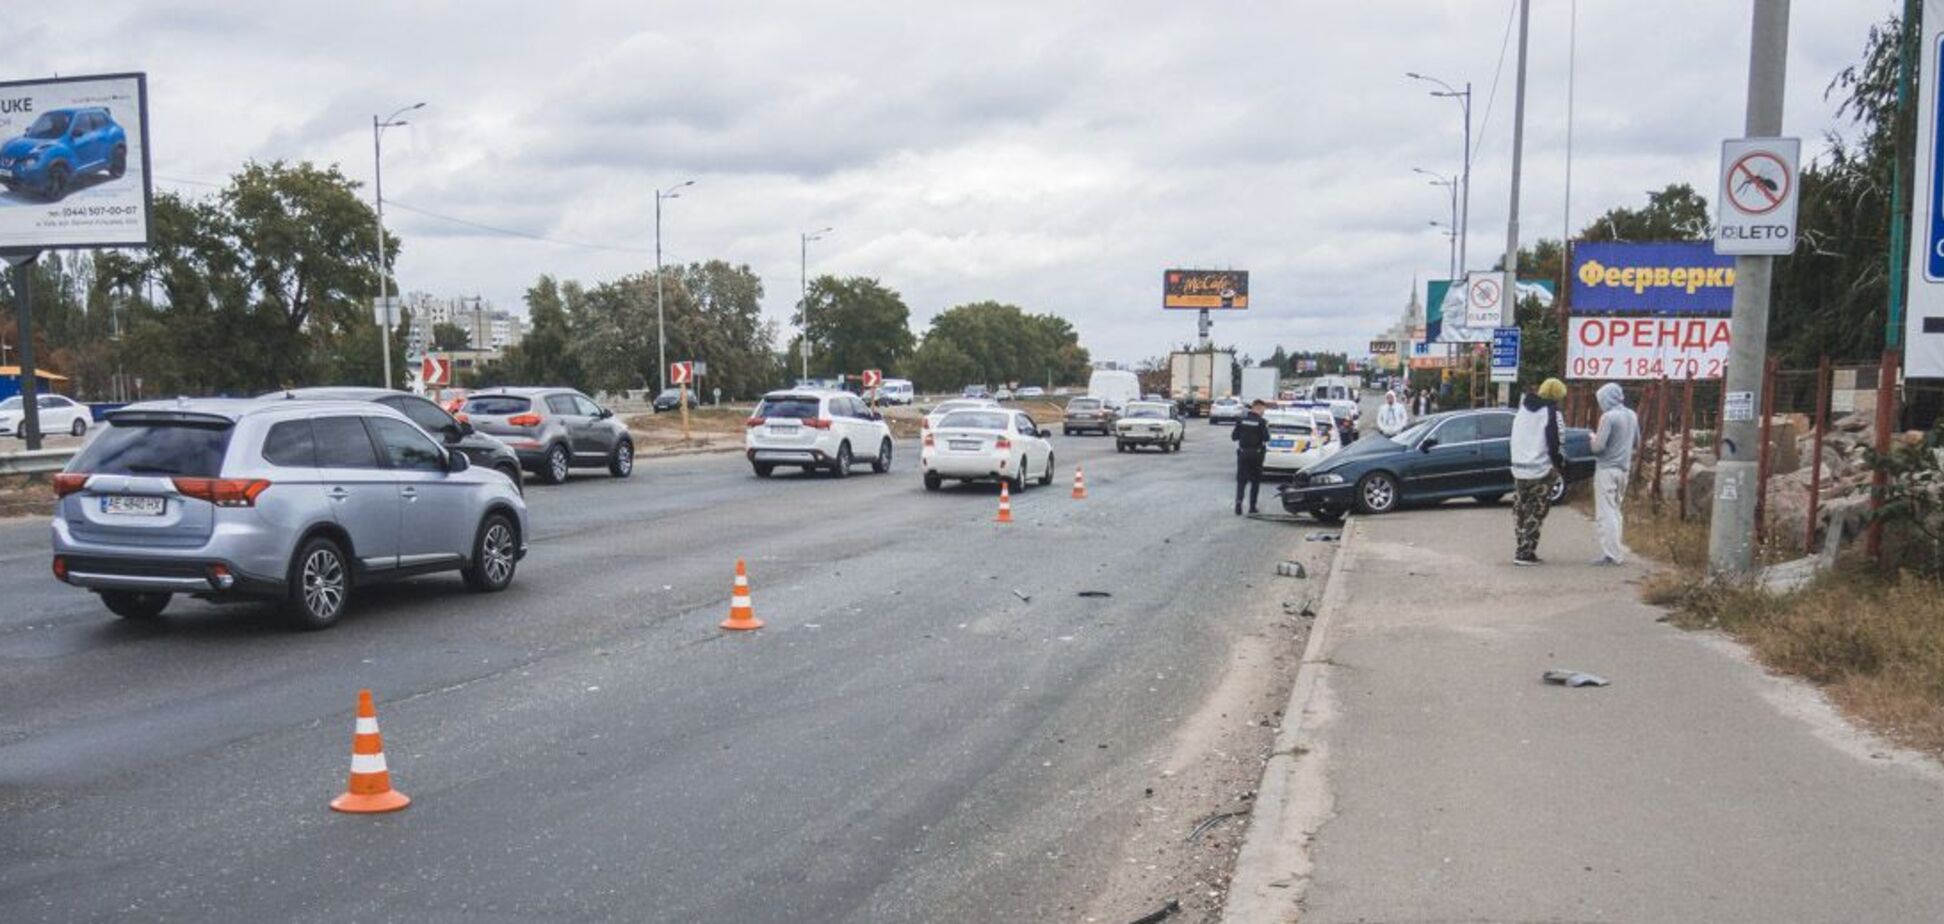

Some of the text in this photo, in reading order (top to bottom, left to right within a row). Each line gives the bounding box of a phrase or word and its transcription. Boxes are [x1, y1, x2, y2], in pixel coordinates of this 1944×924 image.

[1579, 319, 1731, 352] ОРЕНДА
[1573, 357, 1728, 378] 097 184 70 2
